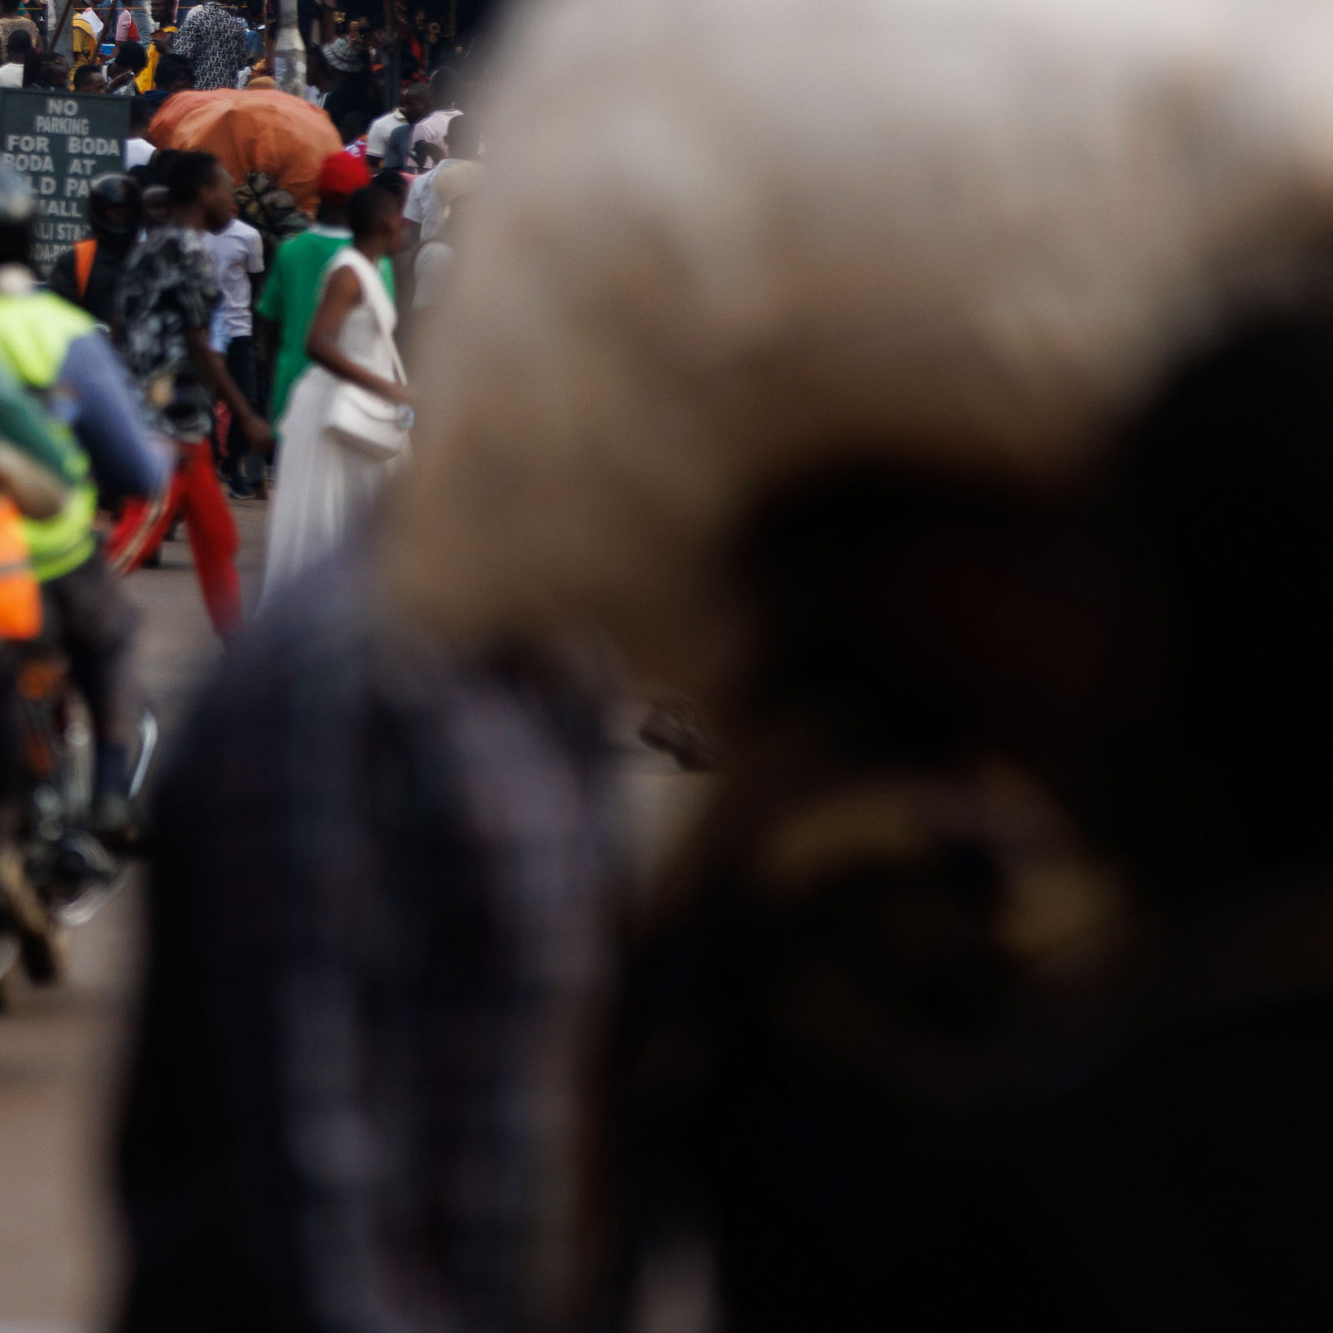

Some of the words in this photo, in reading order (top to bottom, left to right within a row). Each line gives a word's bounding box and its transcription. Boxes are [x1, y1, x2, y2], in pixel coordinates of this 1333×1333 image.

[46, 98, 79, 115] NO
[36, 116, 90, 135] PARKING
[6, 135, 50, 153] FOR
[68, 137, 120, 157] BODA
[69, 158, 97, 175] AT
